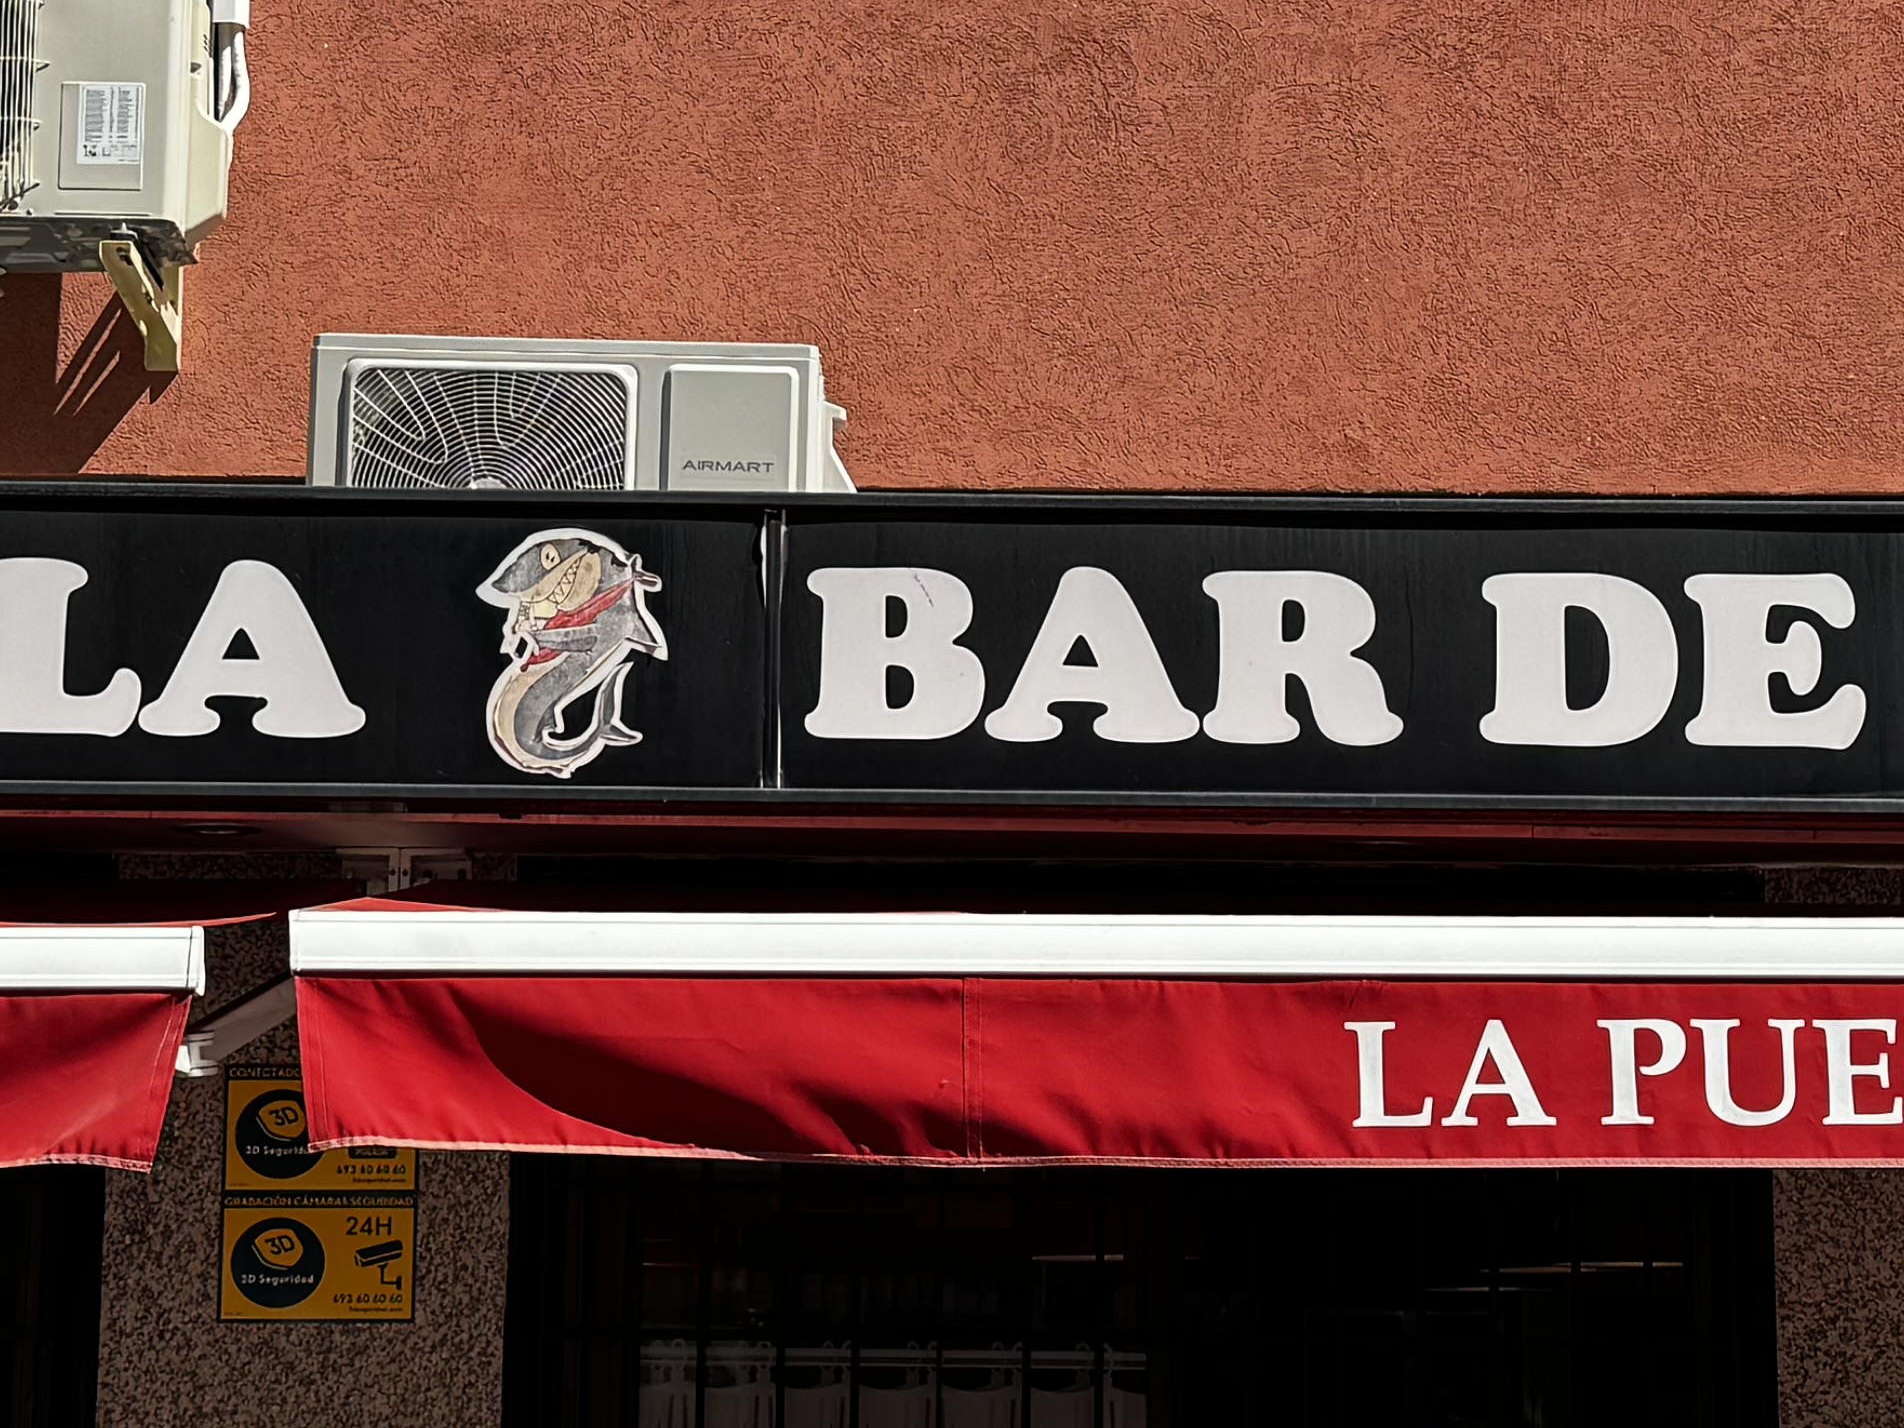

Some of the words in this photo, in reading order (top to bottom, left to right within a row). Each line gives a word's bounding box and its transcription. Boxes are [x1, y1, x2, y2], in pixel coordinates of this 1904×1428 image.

[682, 459, 775, 473] AIRMART
[804, 566, 1404, 746] BAR
[1479, 572, 1867, 750] DE
[1344, 1019, 1557, 1128] LA
[269, 1106, 299, 1127] 3D
[346, 1217, 393, 1236] 24H
[265, 1235, 296, 1255] 3D
[259, 1274, 315, 1286] Seguridad
